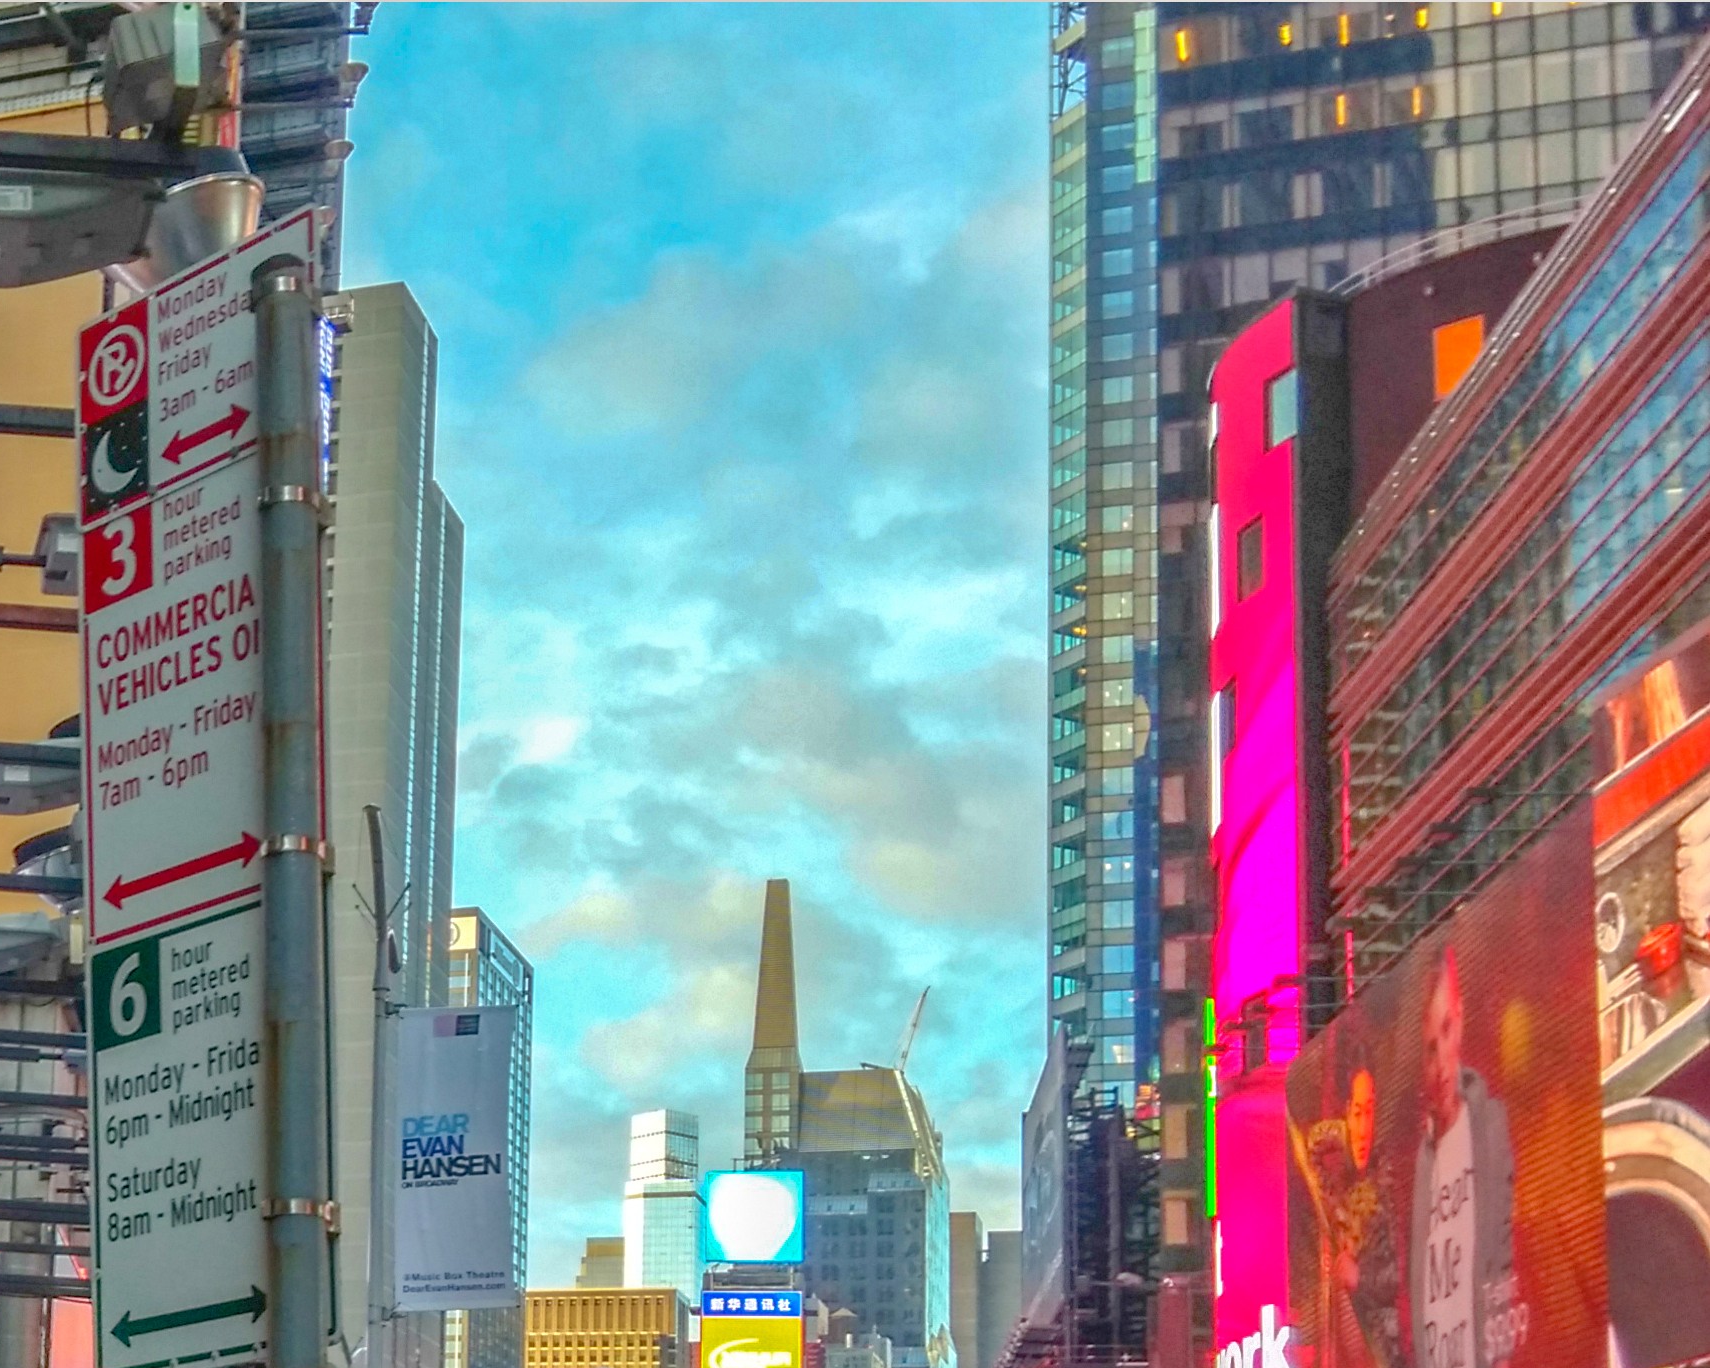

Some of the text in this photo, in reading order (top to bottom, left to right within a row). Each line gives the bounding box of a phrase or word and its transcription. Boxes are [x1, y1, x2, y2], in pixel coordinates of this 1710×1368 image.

[157, 270, 227, 323] Monday
[158, 290, 254, 353] Wednesda
[158, 342, 211, 386] Friday
[160, 390, 196, 422] 3am
[215, 362, 254, 394] 6am
[163, 484, 205, 520] hour
[164, 500, 240, 550] metered
[101, 515, 137, 596] 3
[164, 534, 231, 586] parking
[97, 573, 255, 669] COMMERCIA
[98, 635, 222, 716] VEHICLES
[99, 721, 173, 773] Monday
[194, 691, 257, 736] Friday
[99, 776, 140, 810] 7am
[163, 749, 208, 789] 6pm
[171, 941, 212, 972] hour
[172, 954, 250, 1000] metered
[110, 951, 147, 1037] 6
[172, 991, 240, 1034] parking
[105, 1061, 185, 1105] Monday
[207, 1040, 260, 1077] Frida
[106, 1114, 149, 1148] 6pm
[169, 1077, 254, 1129] Midnight
[403, 1113, 469, 1137] DEAR
[402, 1135, 464, 1159] EVAN
[402, 1153, 501, 1180] HANSEN
[107, 1157, 201, 1202] Saturday
[107, 1212, 150, 1242] 8am
[171, 1178, 257, 1228] Midnight
[710, 1298, 792, 1312] 新华通讯社
